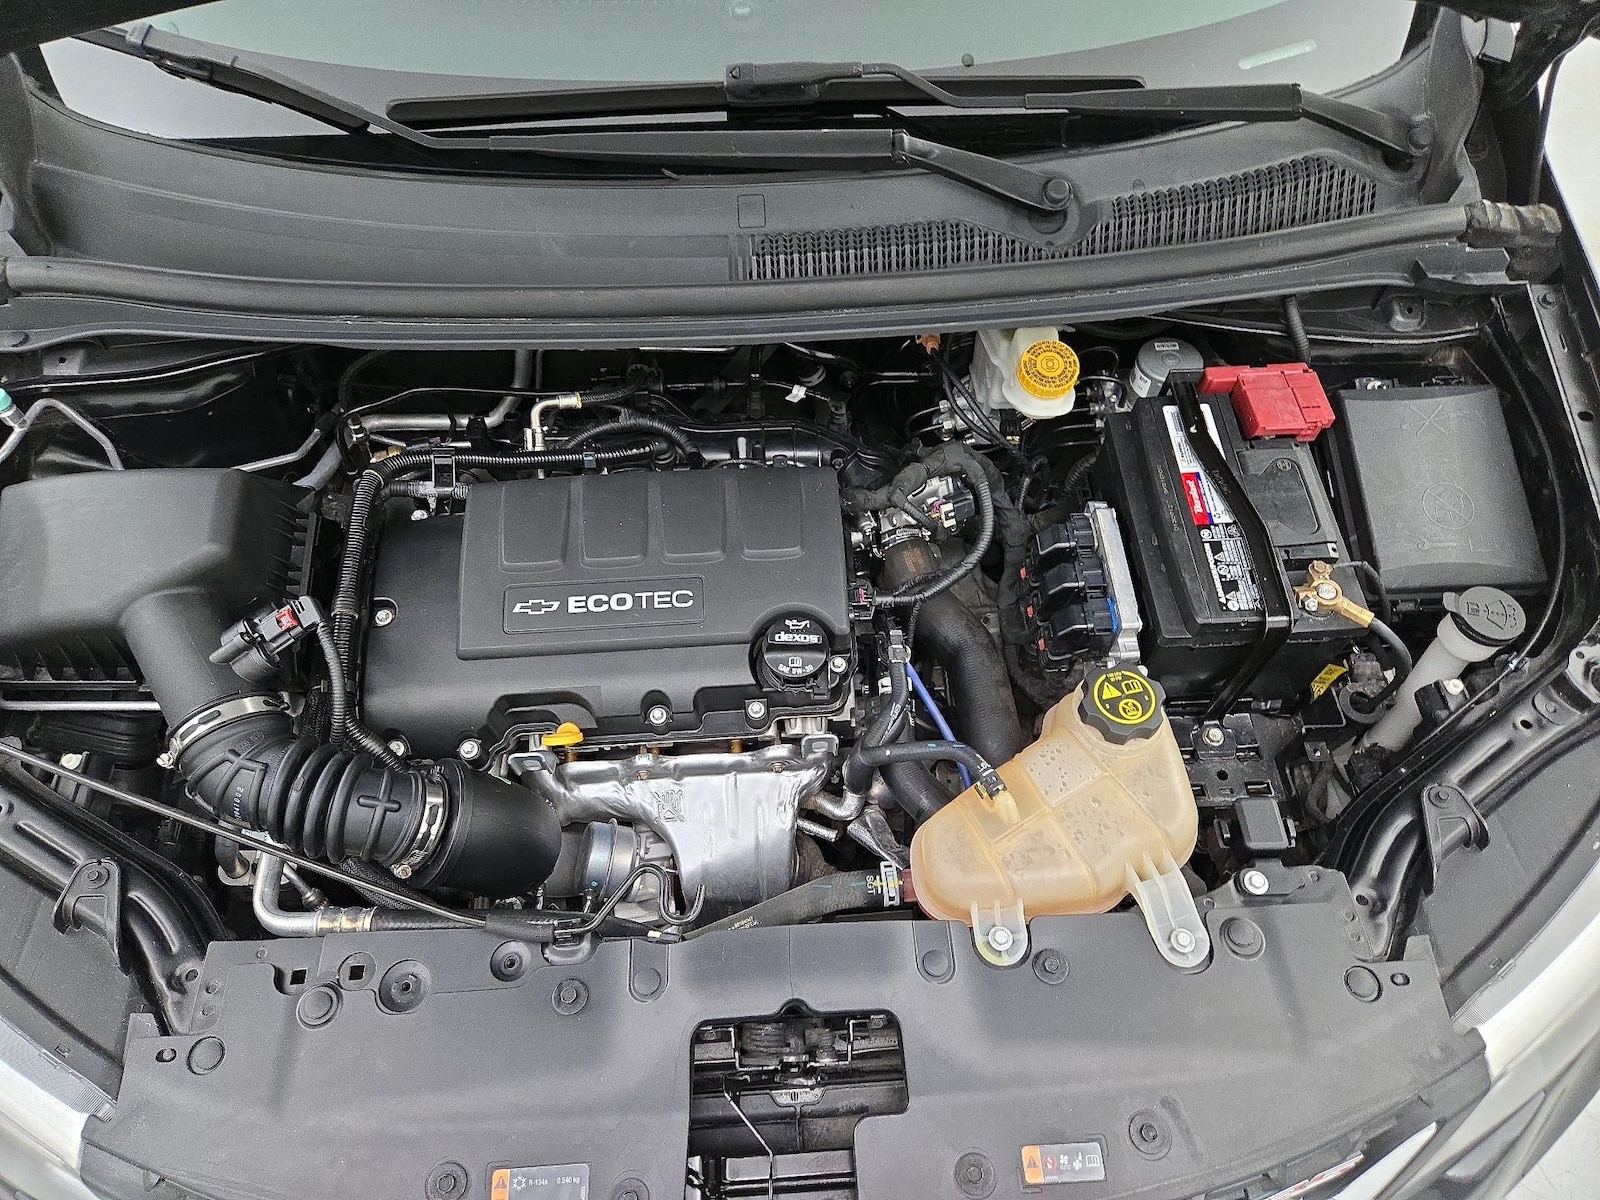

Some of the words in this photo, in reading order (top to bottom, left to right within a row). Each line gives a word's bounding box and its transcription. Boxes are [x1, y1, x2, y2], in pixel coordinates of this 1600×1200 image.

[1185, 479, 1203, 514] Duralast
[567, 590, 694, 613] ECOTEC
[775, 631, 820, 643] dexos
[778, 664, 791, 674] SAE
[791, 664, 814, 674] 5W-30
[866, 875, 876, 895] SGT
